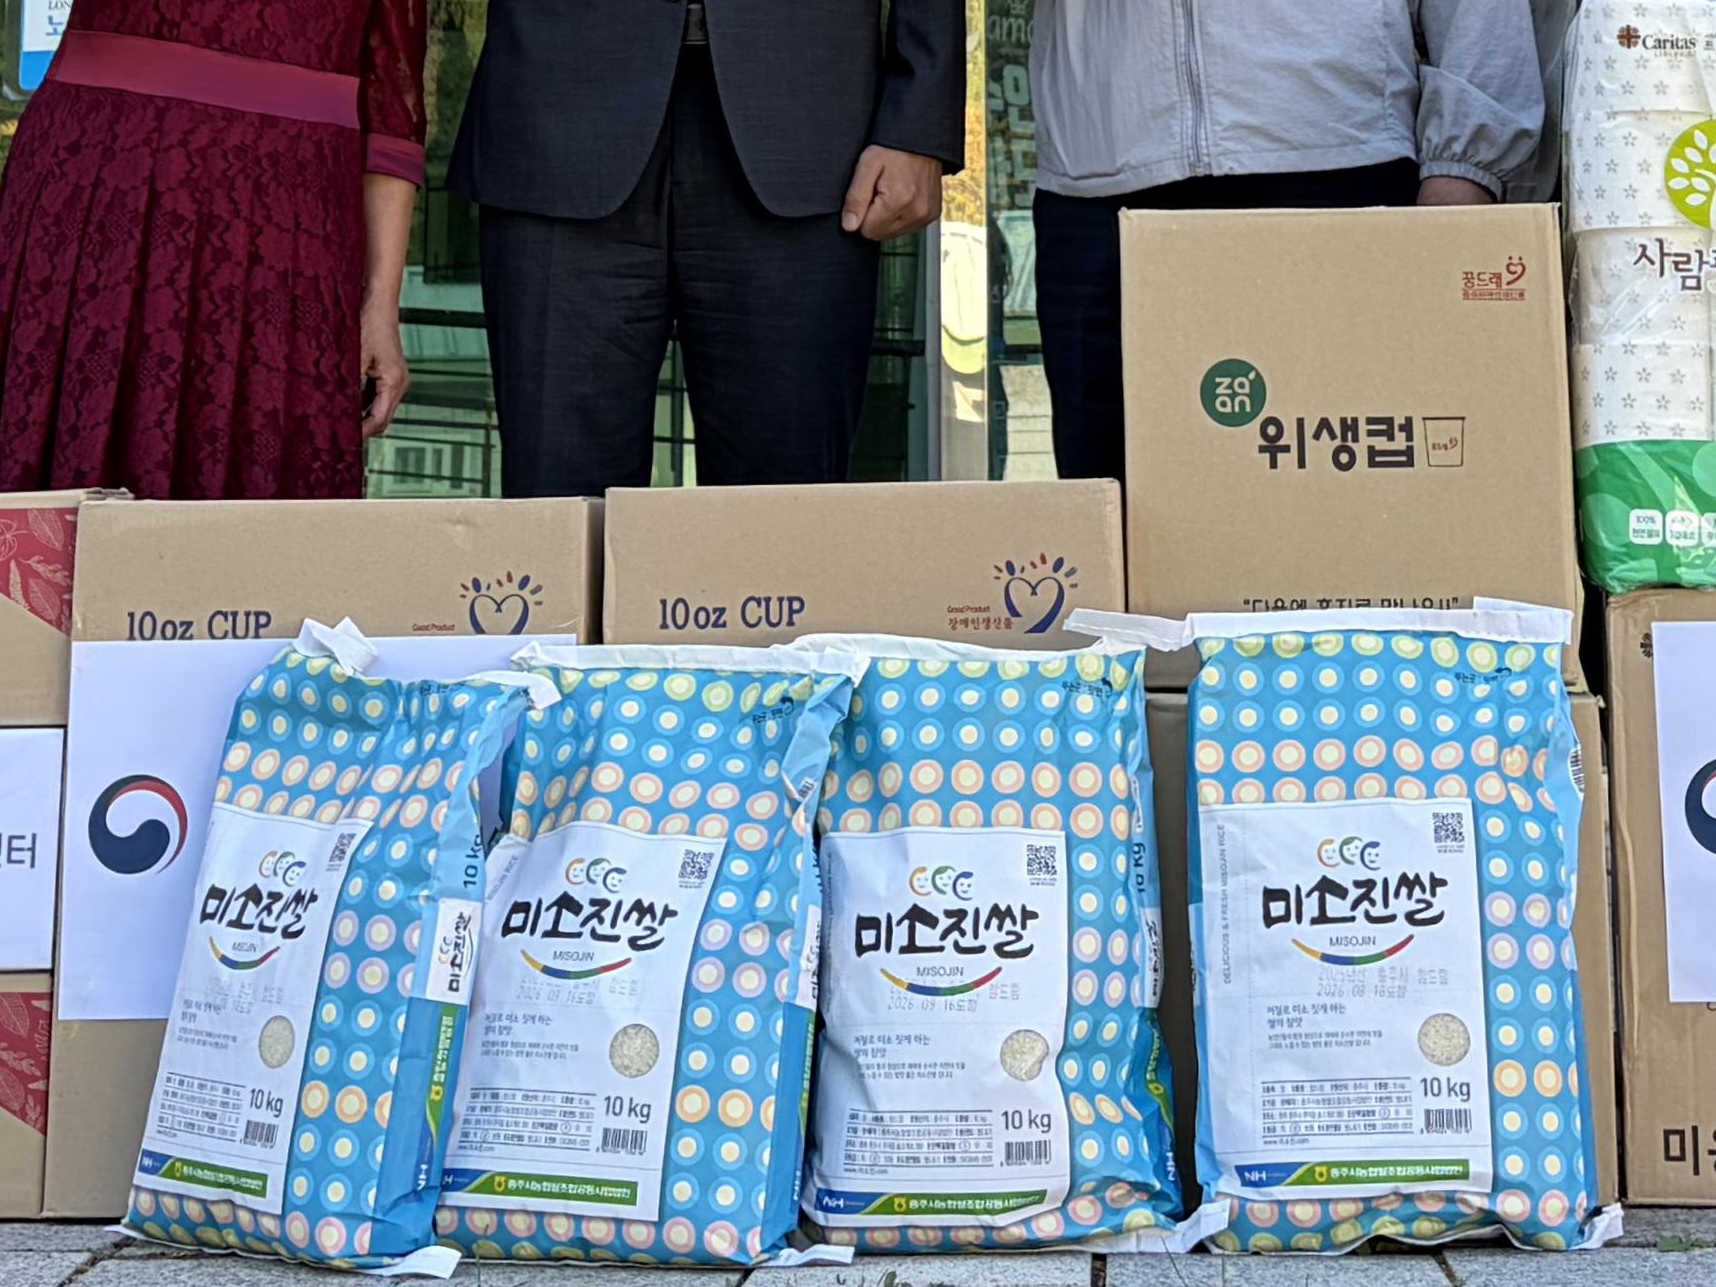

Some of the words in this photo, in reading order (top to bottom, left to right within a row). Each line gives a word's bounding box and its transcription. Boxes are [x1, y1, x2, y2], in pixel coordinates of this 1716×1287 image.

[1642, 34, 1696, 51] Caritas
[1462, 271, 1502, 288] 꿈드래
[1258, 416, 1415, 472] 위생컵
[741, 596, 805, 629] CUP
[207, 610, 272, 641] CUP
[462, 865, 478, 889] 10
[200, 883, 318, 940] 미소진쌀
[1262, 871, 1448, 929] 미소진쌀
[501, 891, 678, 951] 미소진쌀
[855, 901, 1040, 959] 미소진쌀
[1329, 936, 1376, 947] MISOJIN
[552, 951, 594, 961] MISOJIN
[917, 966, 964, 977] MISOJIN
[1420, 1077, 1441, 1098] 10
[1447, 1077, 1471, 1102] kg
[250, 1088, 264, 1110] 10
[266, 1090, 284, 1118] kg
[604, 1095, 623, 1116] 10
[627, 1097, 652, 1124] kg
[1001, 1110, 1023, 1131] 10
[1028, 1109, 1051, 1133] kg
[142, 1156, 153, 1168] NH
[1245, 1171, 1266, 1181] NH
[822, 1197, 844, 1209] NH
